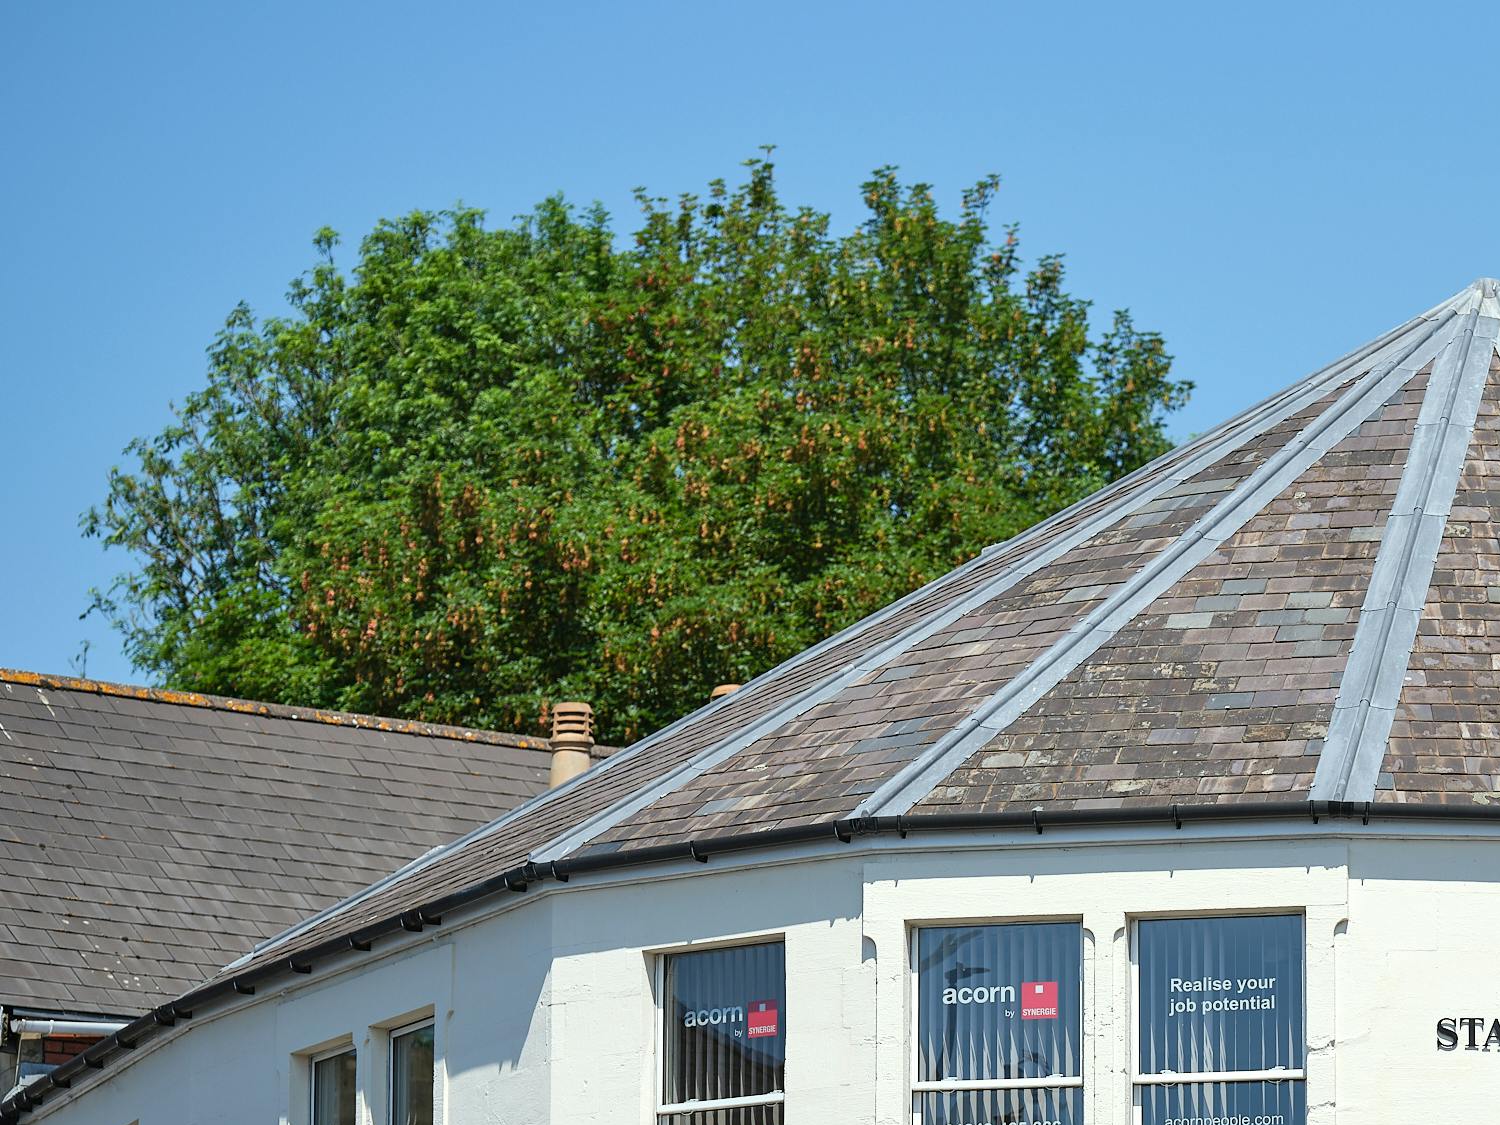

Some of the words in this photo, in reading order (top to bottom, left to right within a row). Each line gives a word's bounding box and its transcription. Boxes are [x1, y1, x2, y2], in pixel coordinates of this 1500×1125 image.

[1170, 977, 1232, 992] Realise
[1237, 978, 1275, 994] your
[942, 986, 1015, 1004] acorn
[1005, 1010, 1015, 1018] by
[1023, 1008, 1056, 1016] SYNERGIE
[1169, 998, 1196, 1017] job
[1202, 995, 1275, 1015] potential
[684, 1006, 743, 1027] acorn
[748, 1025, 776, 1035] SYNERGIE
